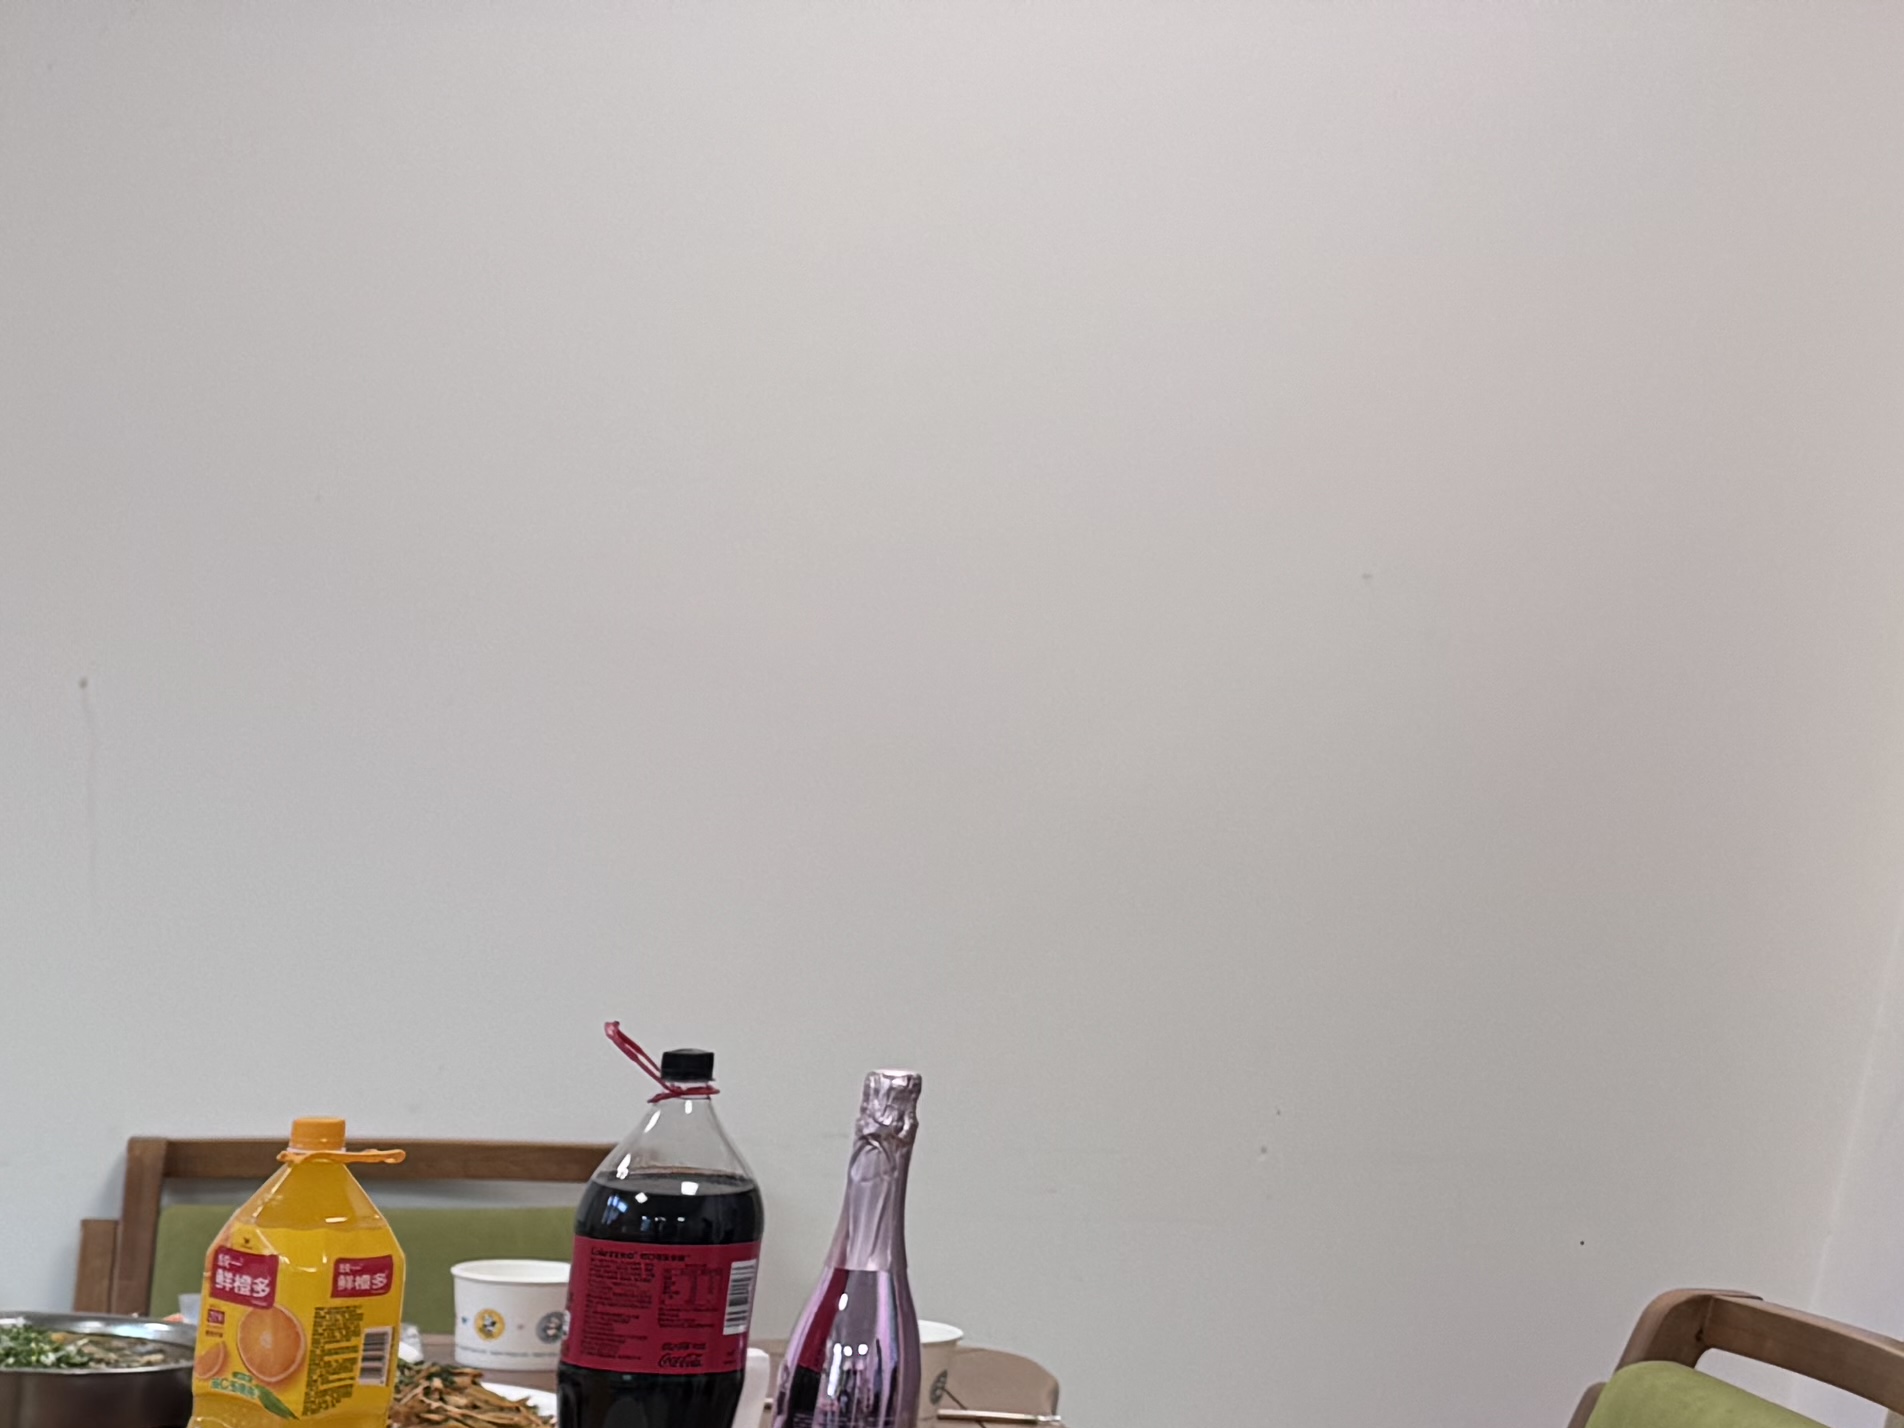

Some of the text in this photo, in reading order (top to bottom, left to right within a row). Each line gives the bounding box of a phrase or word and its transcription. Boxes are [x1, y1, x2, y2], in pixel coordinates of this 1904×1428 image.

[215, 1268, 271, 1298] 鲜橙多
[337, 1272, 388, 1291] 鲜橙多
